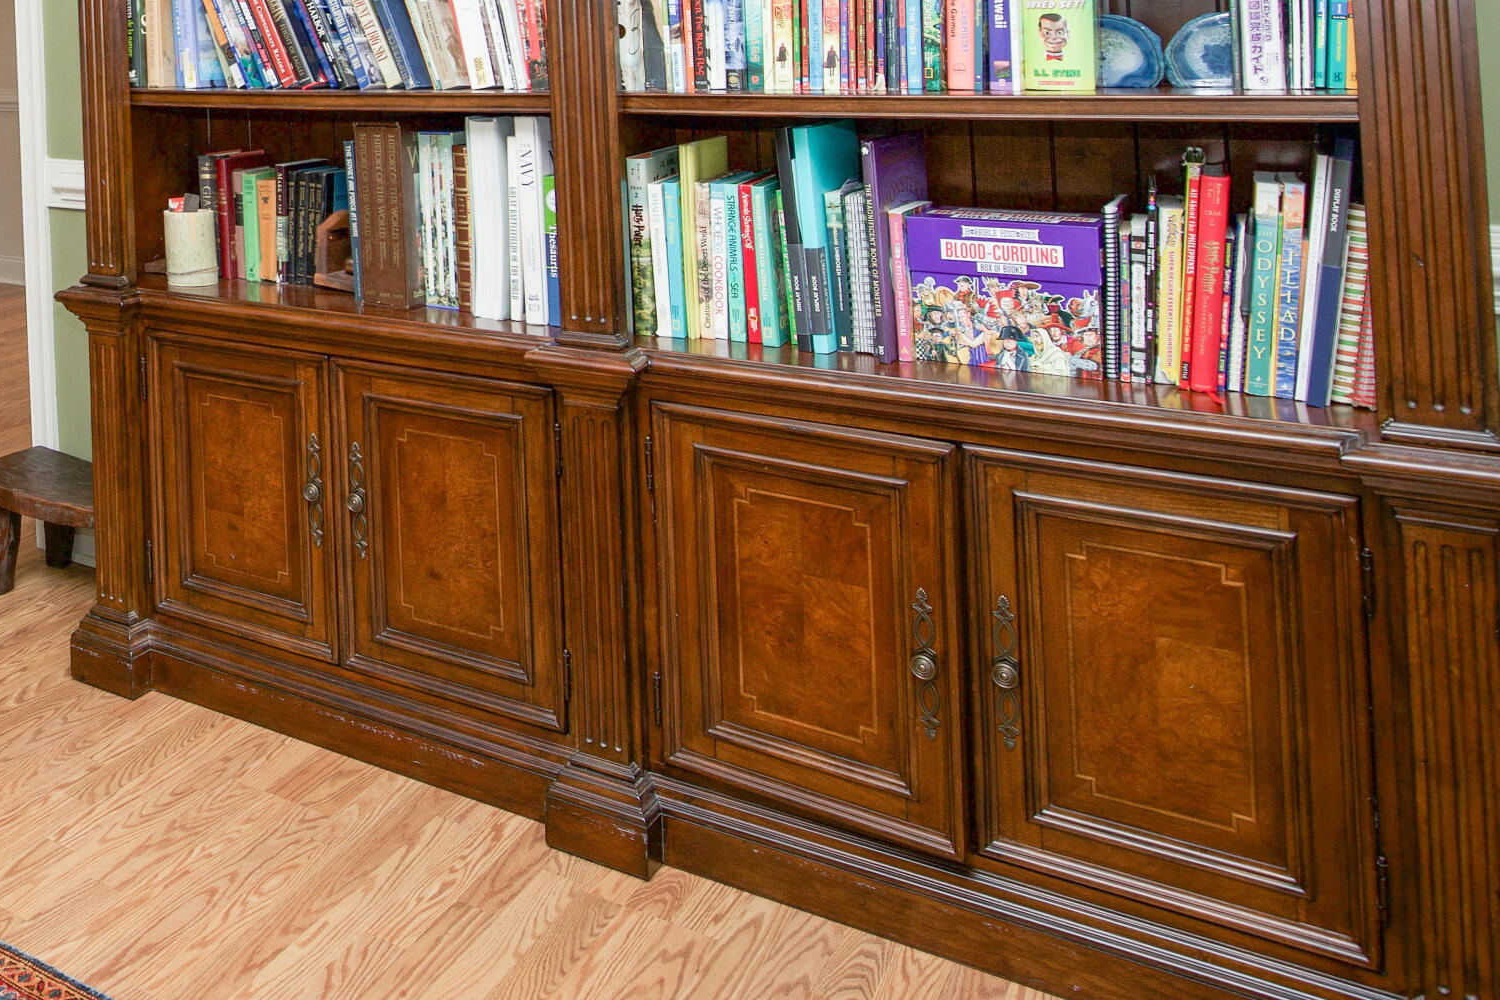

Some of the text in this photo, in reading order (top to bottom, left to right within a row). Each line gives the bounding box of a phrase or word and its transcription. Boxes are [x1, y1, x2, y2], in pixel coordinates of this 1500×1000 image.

[922, 0, 934, 30] FOREST
[1059, 0, 1085, 9] SET!
[306, 2, 327, 38] HARBOR
[362, 19, 374, 31] AT
[695, 15, 704, 31] THE
[949, 8, 957, 39] Garmus
[255, 5, 275, 48] CONFEDERATE
[272, 48, 286, 74] READER
[279, 23, 292, 45] FLIGHT
[290, 55, 305, 77] EAGLES
[366, 31, 380, 45] BIG
[696, 31, 705, 56] BLACK
[372, 45, 389, 63] SKY
[697, 56, 706, 76] FLAG
[346, 158, 354, 179] SOVIET
[520, 150, 533, 188] NAVY
[348, 180, 356, 191] AIR
[348, 191, 357, 211] FORCE
[741, 191, 751, 216] Animals
[1329, 187, 1341, 233] DISPLAY BOOK
[351, 222, 359, 238] WAR
[631, 203, 646, 248] Harry Potter
[742, 215, 752, 239] Showing
[865, 198, 875, 247] MAGNIFICENT
[964, 227, 997, 236] HORRIBLE
[1186, 187, 1197, 275] All About the PHILIPPINES
[547, 224, 558, 278] Thesaurus
[699, 226, 708, 252] World
[726, 195, 739, 299] STRANGE ANIMALS SEA
[945, 241, 1059, 266] BLOOD-CURDLING
[701, 252, 709, 278] Desert
[869, 247, 878, 268] BOOK
[980, 264, 1024, 275] BOX OF BOOKS
[1201, 240, 1221, 295] Harry Potter
[713, 254, 725, 316] COOKBOOK
[872, 280, 882, 318] MONSTERS
[1254, 239, 1274, 361] ODYSSEY
[1279, 249, 1301, 343] ILIAD
[703, 293, 712, 329] Creatures
[1166, 296, 1174, 332] ESSENTIAL
[1166, 331, 1174, 368] HANDBOOK
